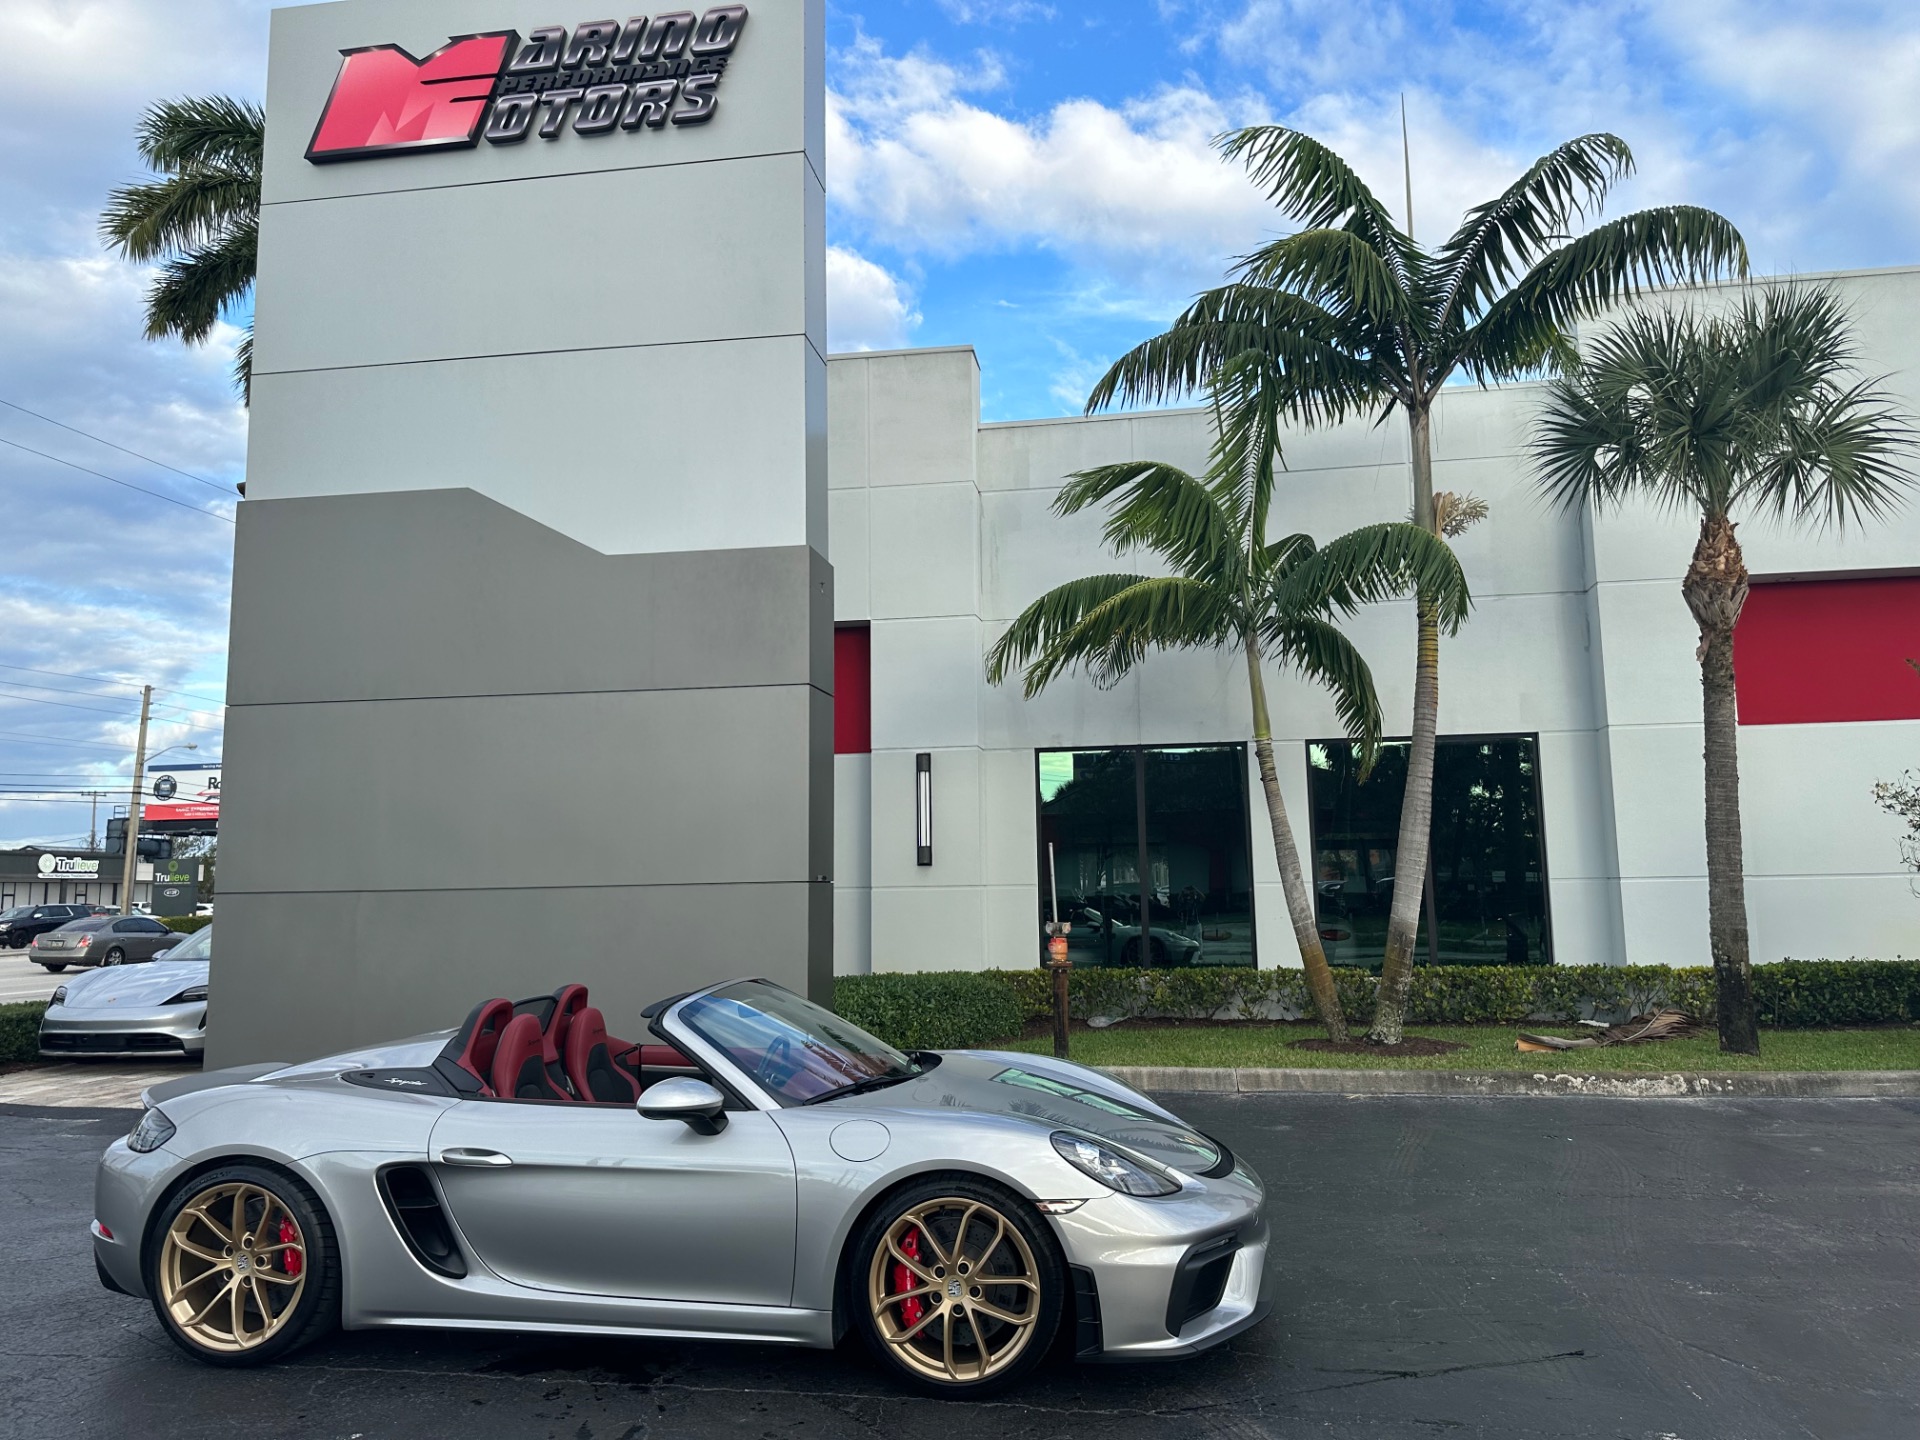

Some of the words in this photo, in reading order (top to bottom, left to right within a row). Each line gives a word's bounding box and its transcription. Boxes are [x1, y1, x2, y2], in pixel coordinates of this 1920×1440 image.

[498, 55, 729, 97] PERFORMANCE
[485, 72, 724, 144] OTORS
[58, 858, 98, 871] Trulieve
[155, 872, 190, 882] Trulieve
